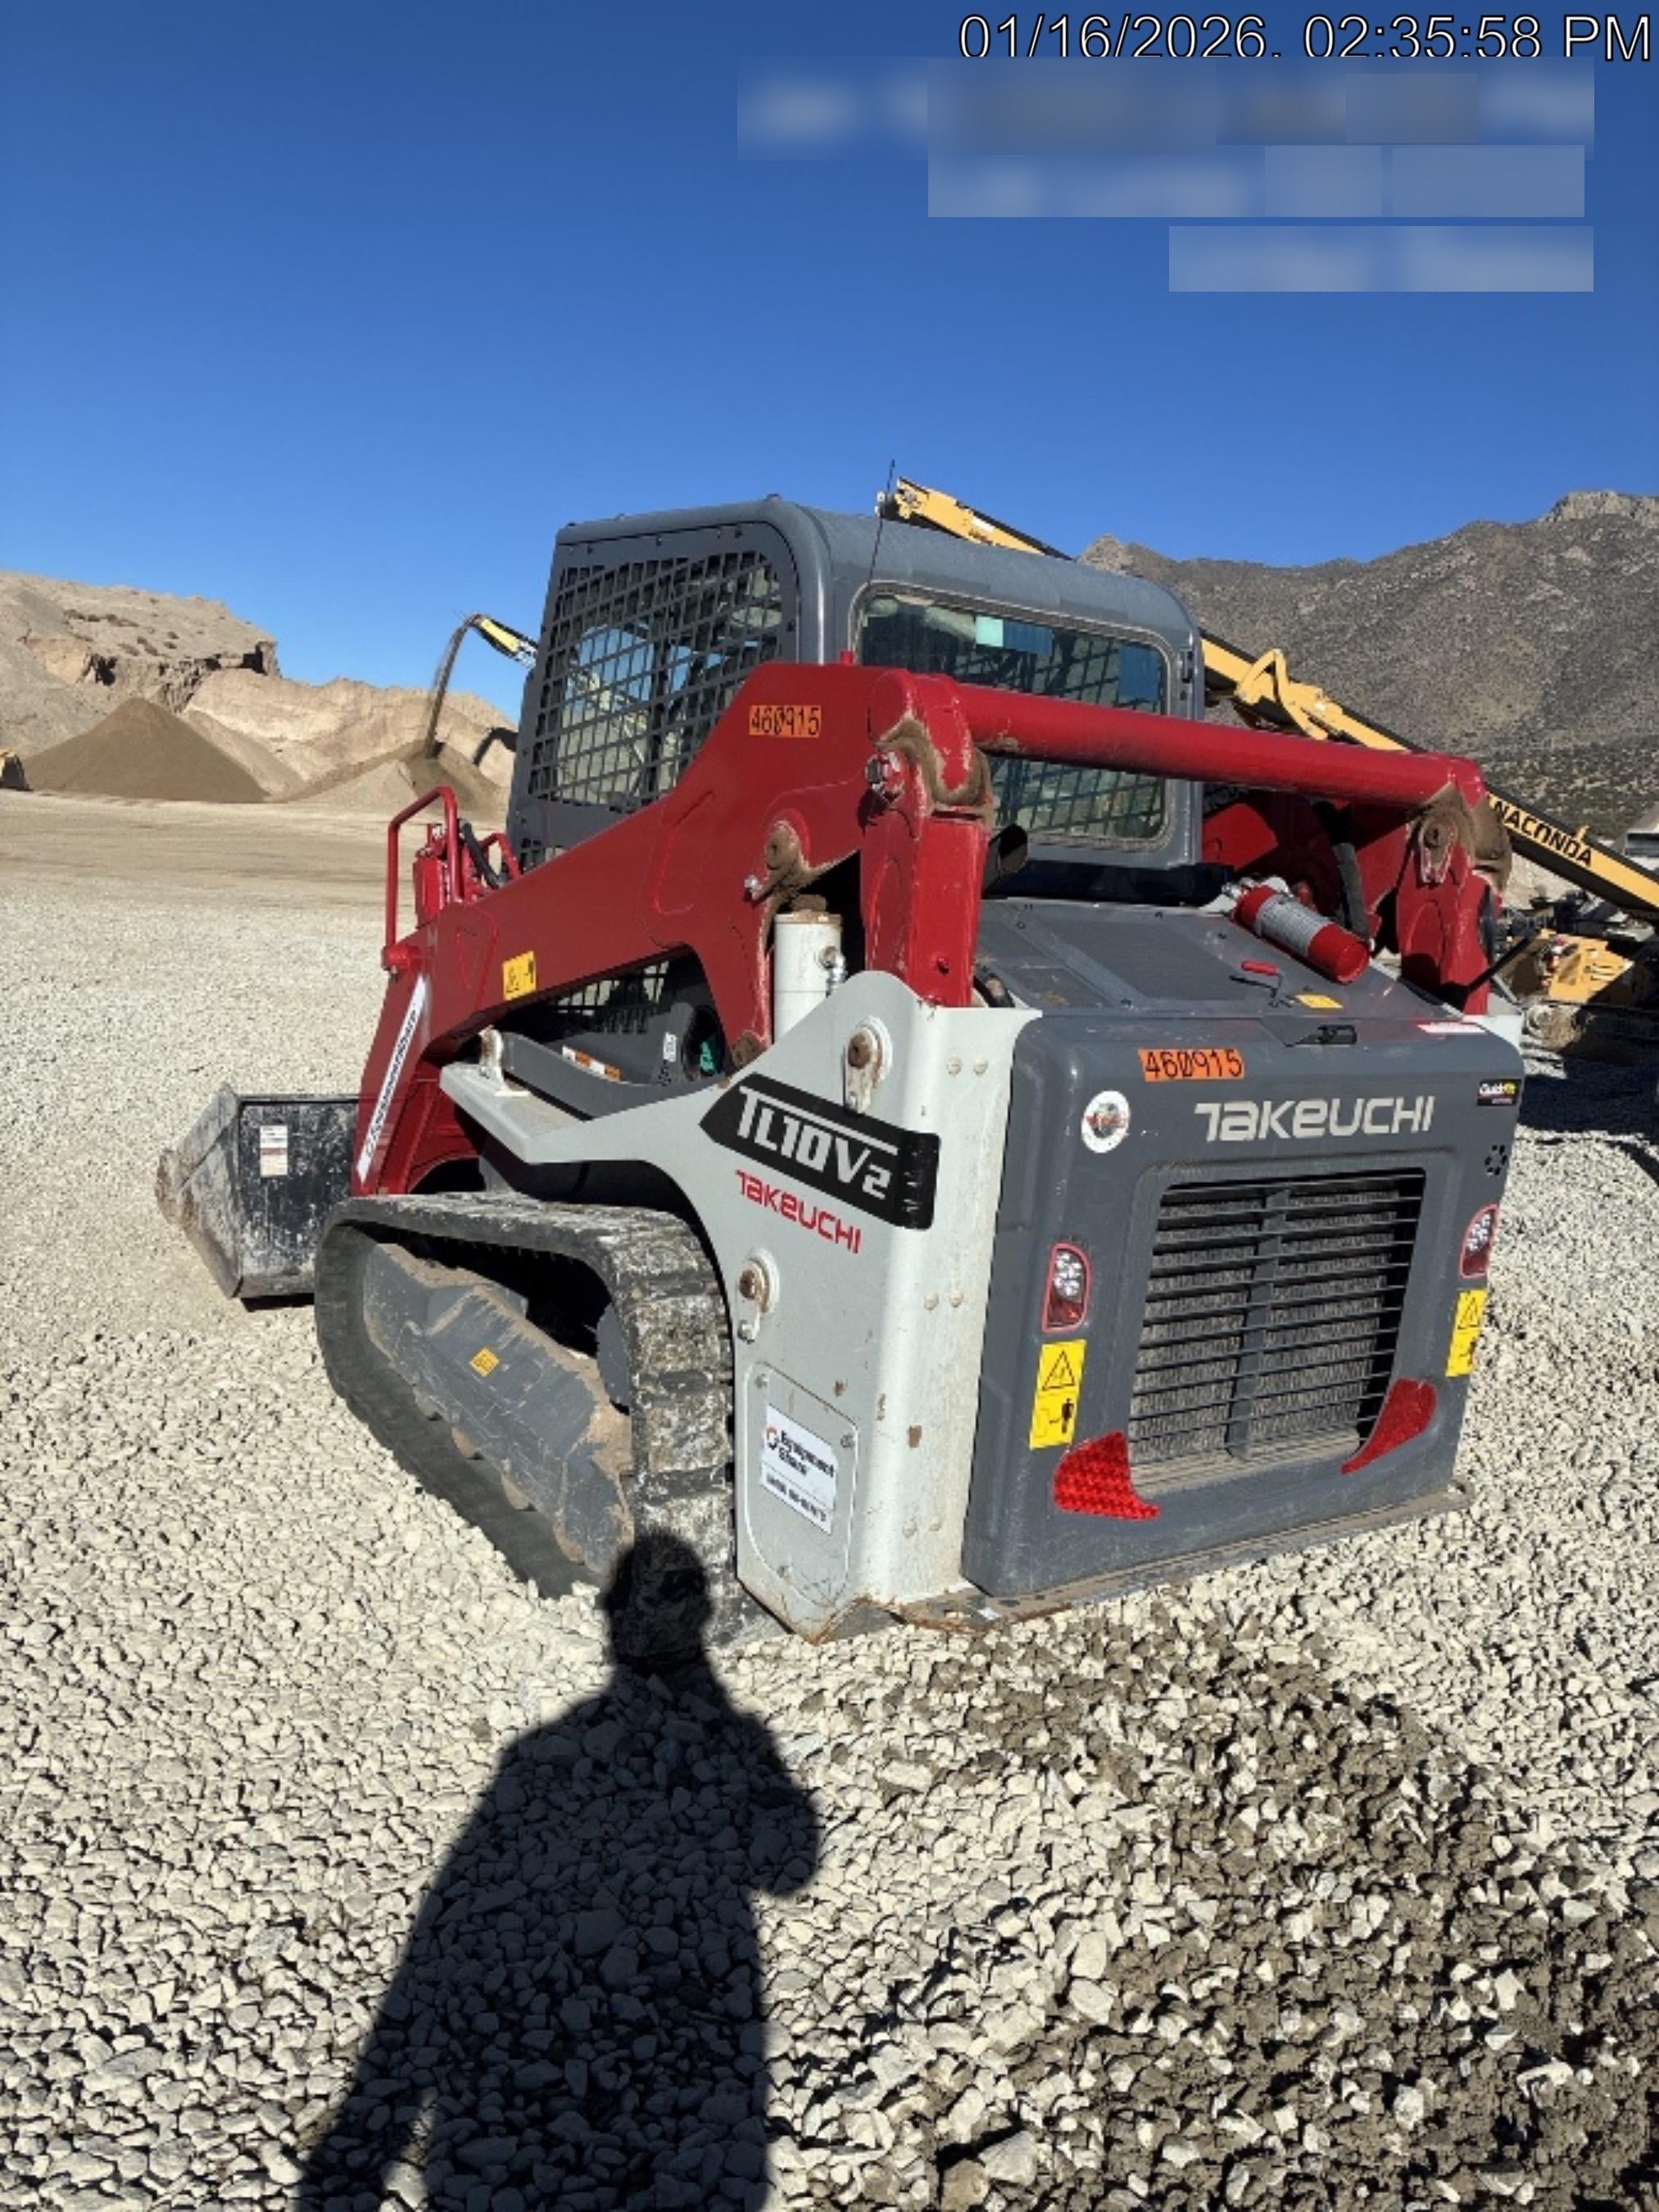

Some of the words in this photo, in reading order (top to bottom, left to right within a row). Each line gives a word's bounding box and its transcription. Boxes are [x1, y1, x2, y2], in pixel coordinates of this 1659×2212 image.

[751, 707, 819, 735] 460915
[1494, 800, 1592, 867] NACONDA
[1145, 1049, 1242, 1078] 460915
